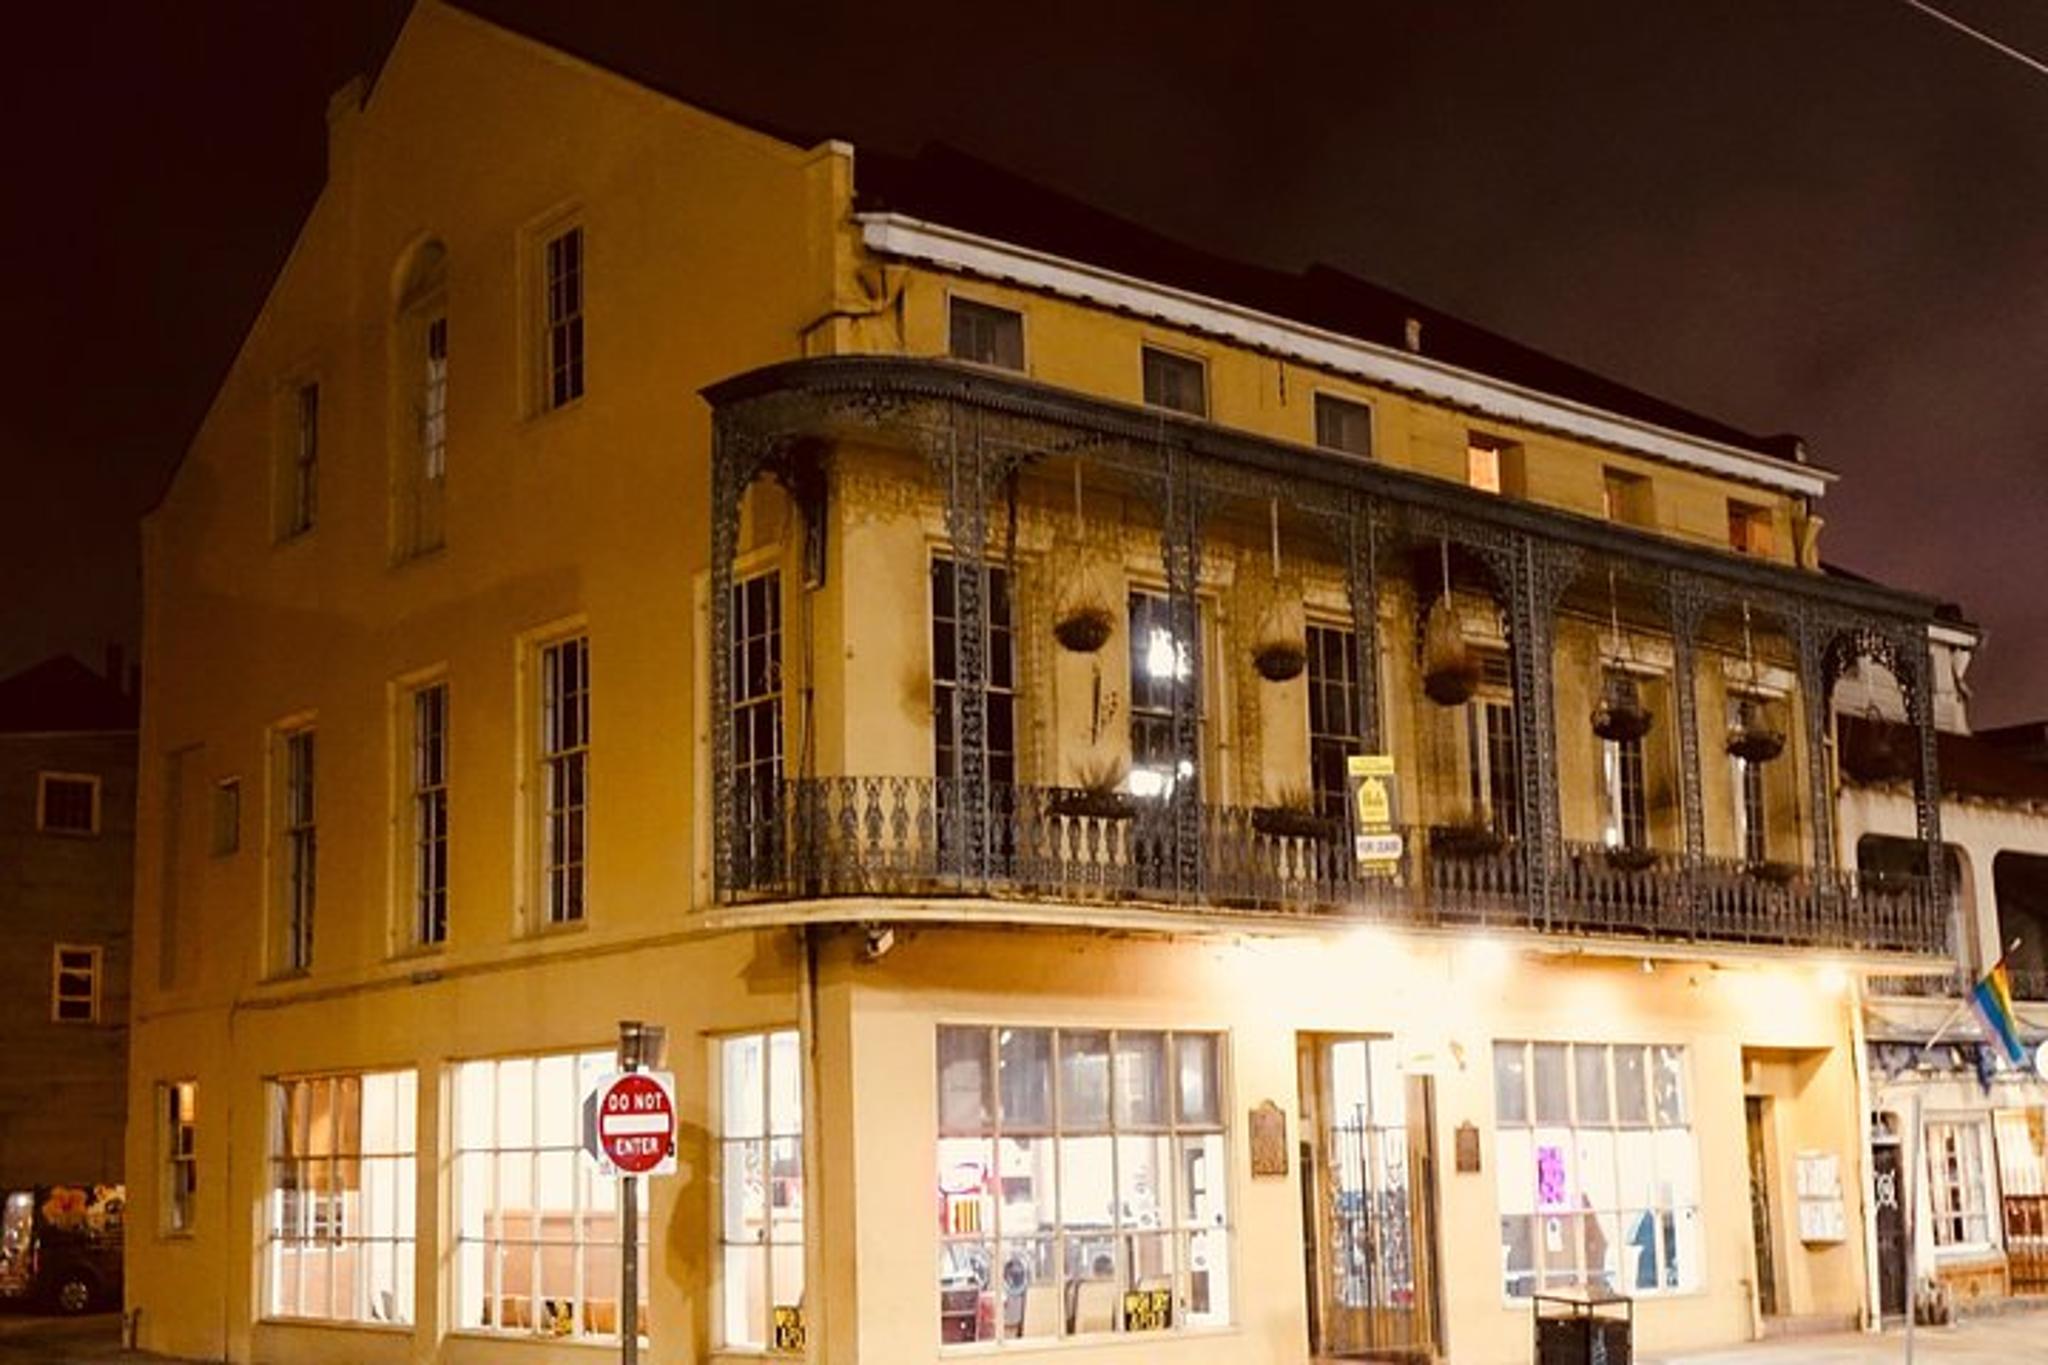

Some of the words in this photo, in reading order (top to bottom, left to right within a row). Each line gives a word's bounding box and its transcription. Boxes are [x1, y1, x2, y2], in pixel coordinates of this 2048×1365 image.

[608, 1094, 630, 1111] DO
[634, 1092, 662, 1110] NOT
[616, 1137, 659, 1156] ENTER
